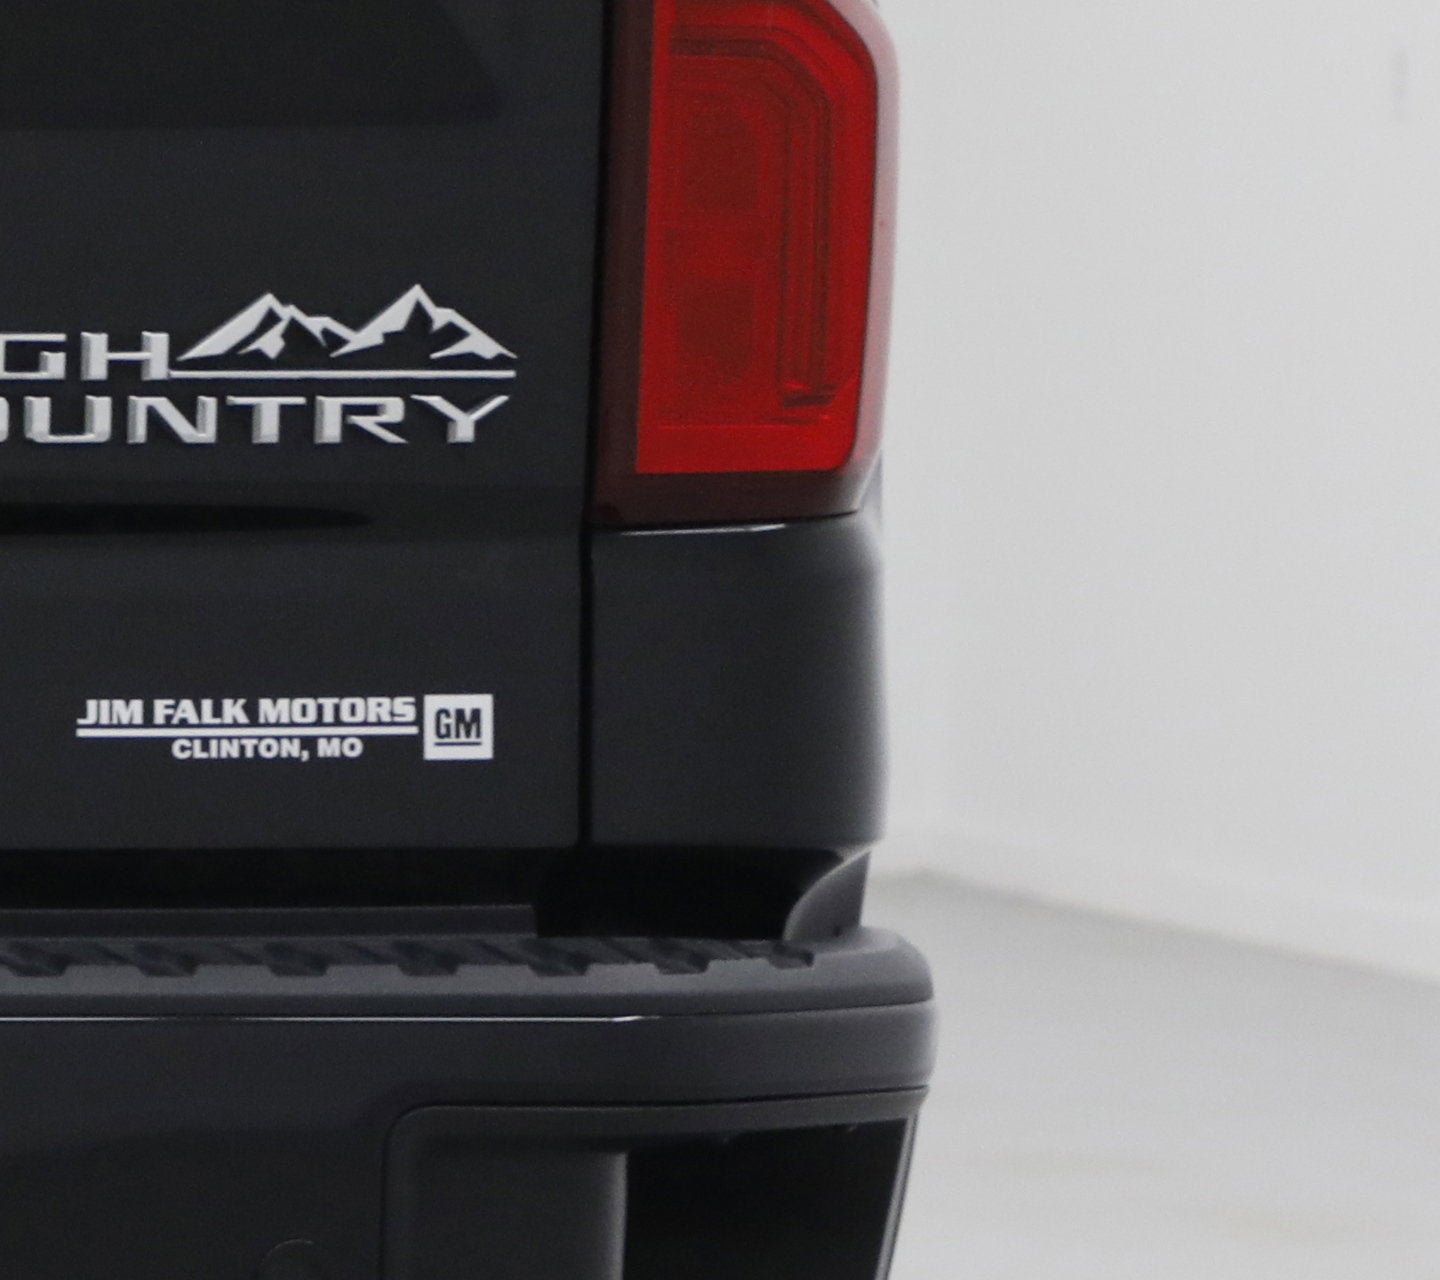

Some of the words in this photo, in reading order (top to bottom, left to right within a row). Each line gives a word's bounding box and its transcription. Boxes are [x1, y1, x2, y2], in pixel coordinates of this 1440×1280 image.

[77, 698, 144, 726] JIM
[153, 698, 250, 726] FALK
[257, 696, 416, 724] MOTORS
[433, 707, 482, 740] GM
[171, 738, 309, 762] CLINTON,
[316, 736, 364, 759] MO
